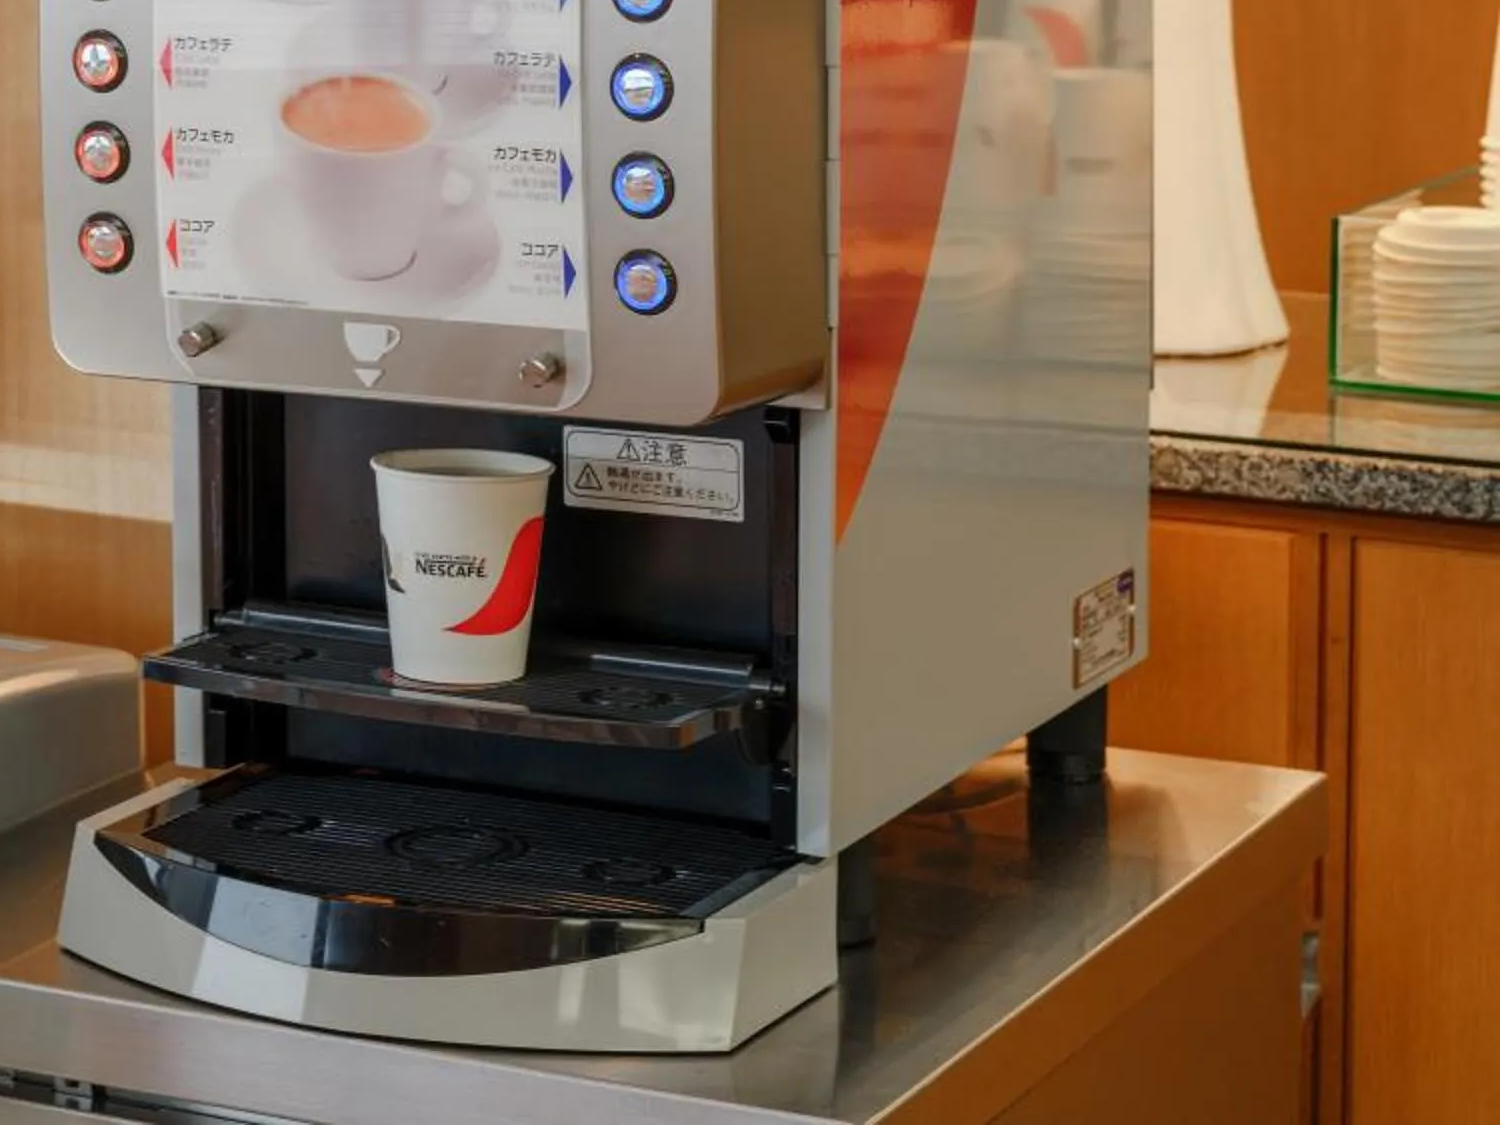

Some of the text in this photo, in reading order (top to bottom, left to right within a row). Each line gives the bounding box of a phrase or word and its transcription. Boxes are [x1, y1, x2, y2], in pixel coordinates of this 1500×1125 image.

[174, 35, 234, 52] カフェラテ
[493, 50, 556, 68] カフェラテ
[176, 127, 235, 144] カフェモカ
[493, 145, 557, 164] カフェモカ
[179, 219, 215, 233] ココア
[521, 241, 559, 258] ココア
[642, 439, 688, 467] 注意
